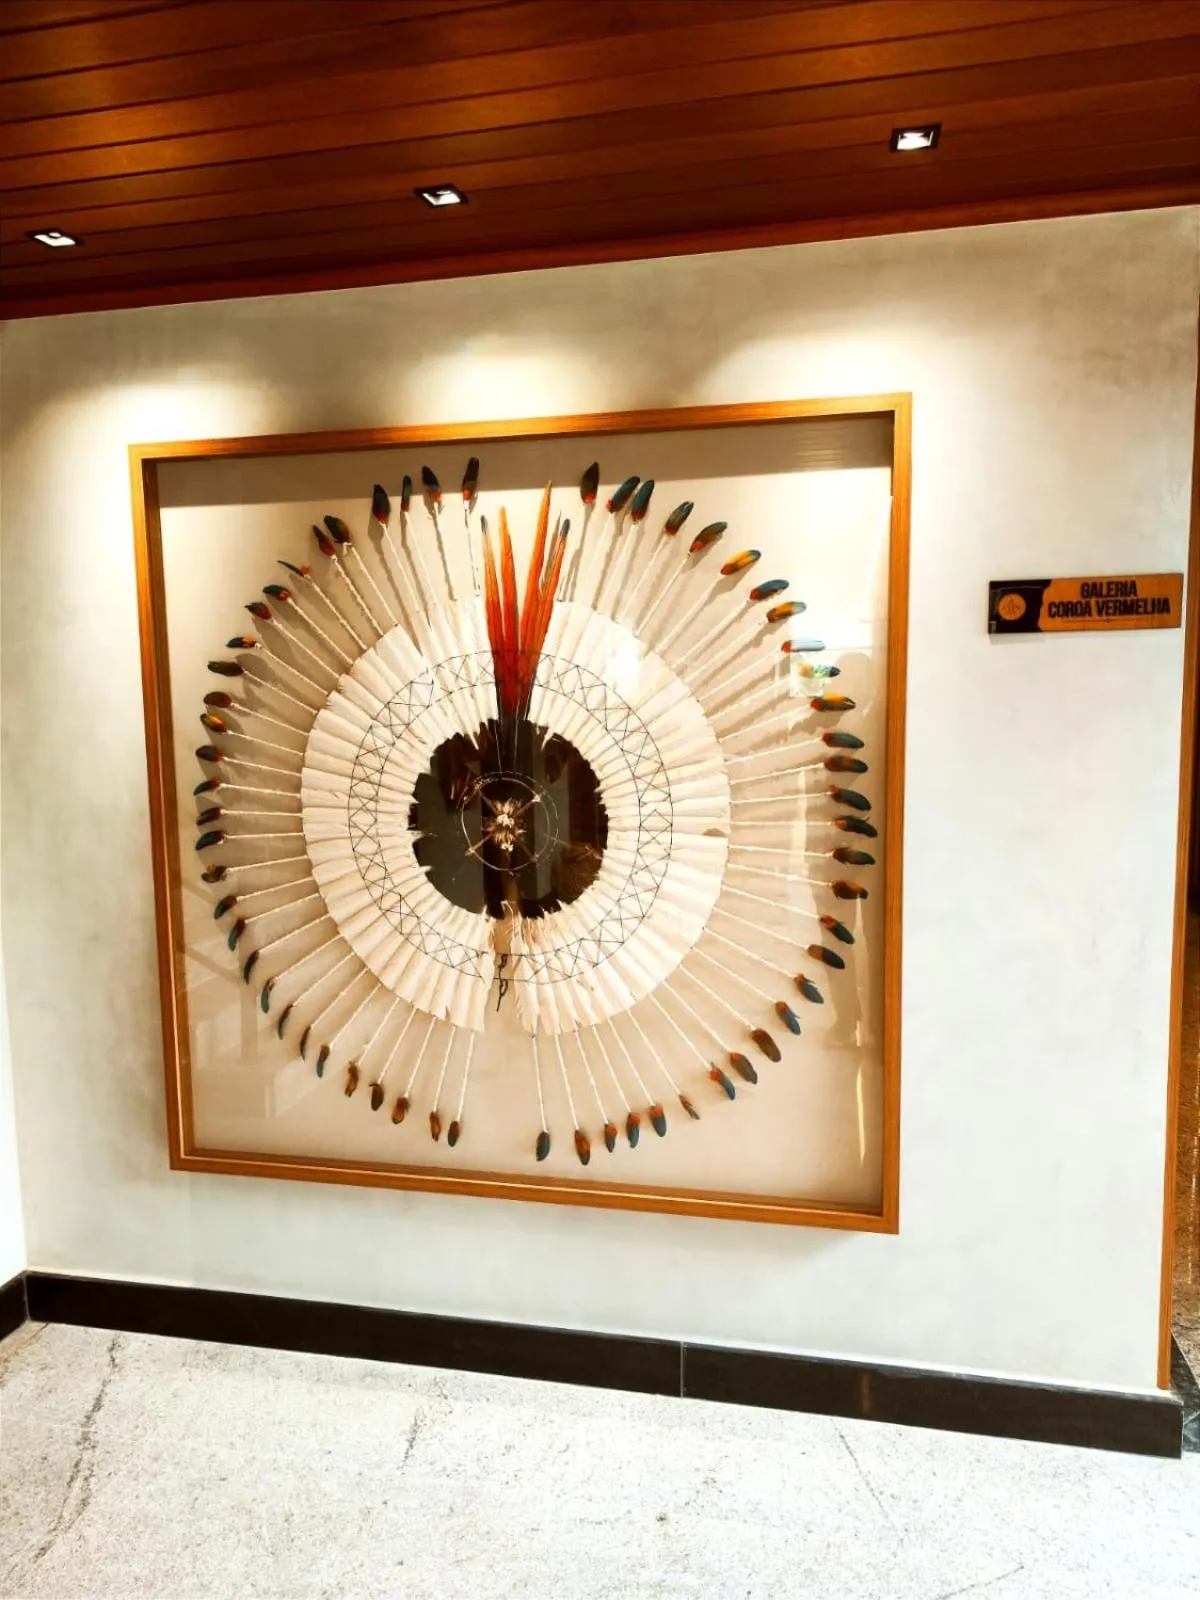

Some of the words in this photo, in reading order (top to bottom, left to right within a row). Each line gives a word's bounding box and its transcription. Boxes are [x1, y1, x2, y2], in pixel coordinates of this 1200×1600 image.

[1080, 580, 1138, 598] GALERIA
[1048, 600, 1092, 618] COROA
[1095, 598, 1171, 617] VERMELHA
